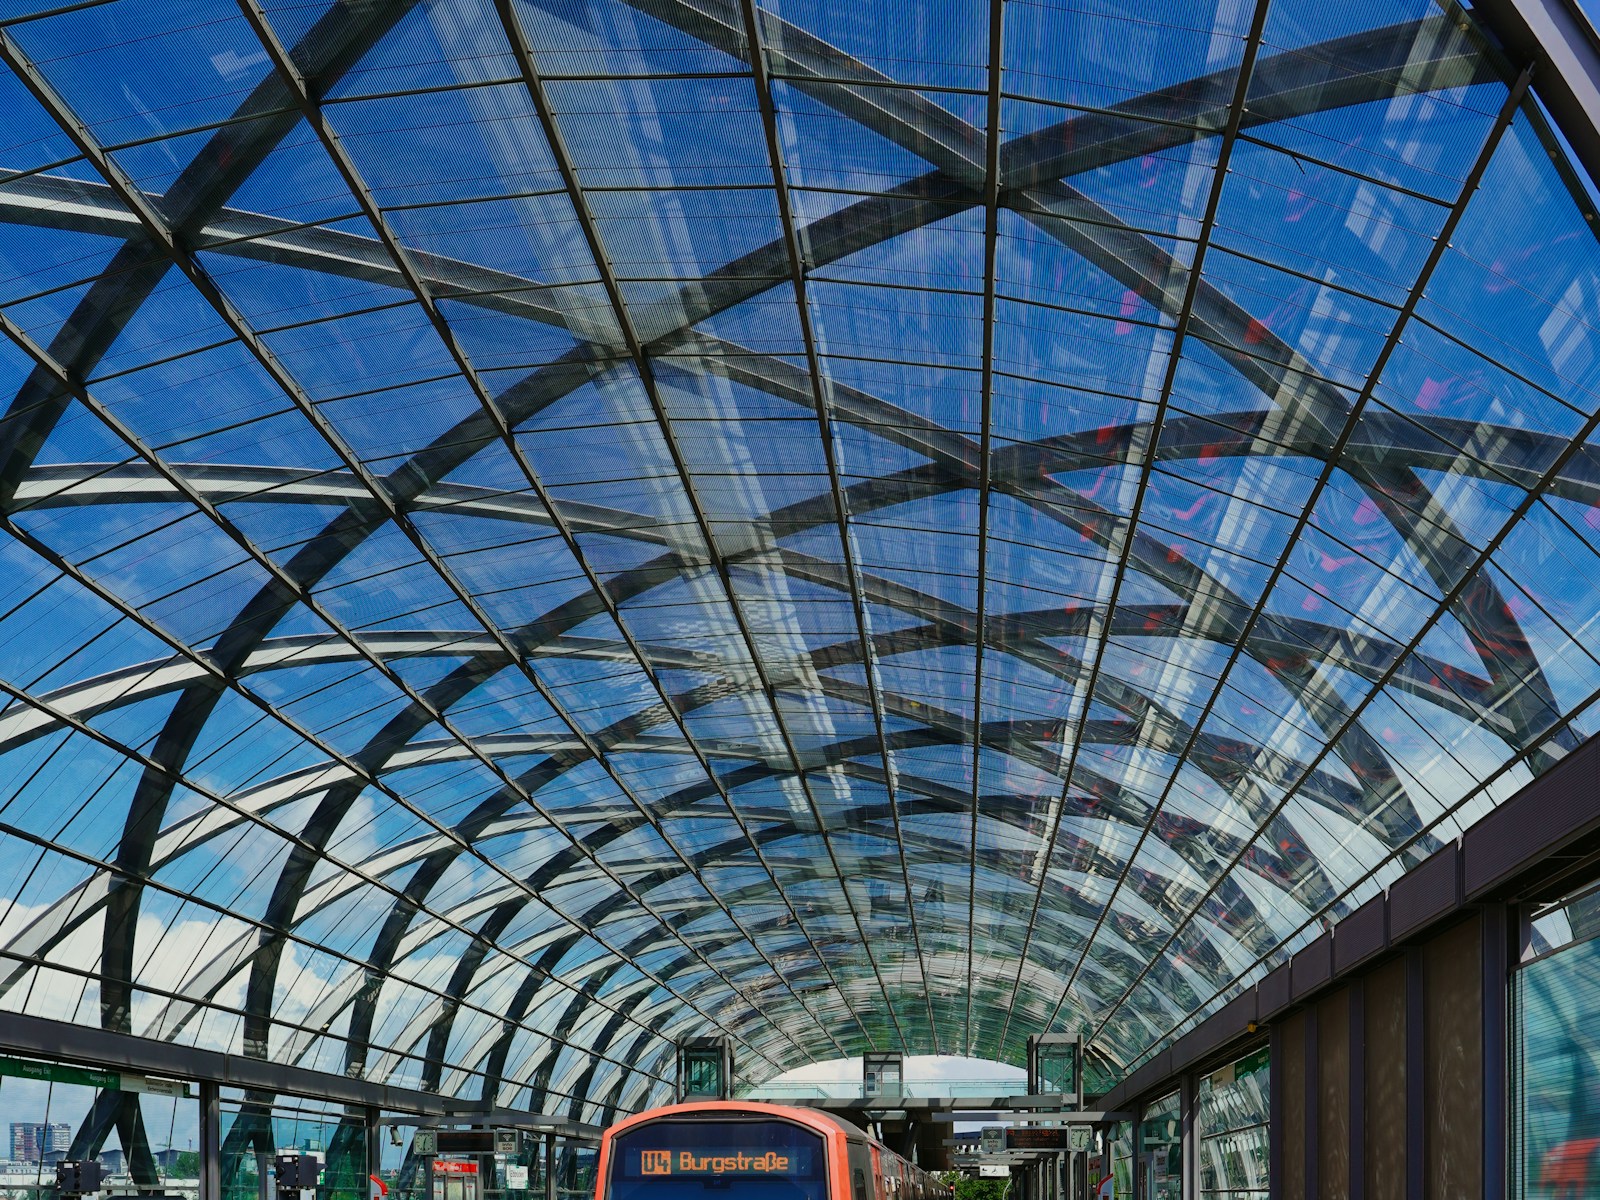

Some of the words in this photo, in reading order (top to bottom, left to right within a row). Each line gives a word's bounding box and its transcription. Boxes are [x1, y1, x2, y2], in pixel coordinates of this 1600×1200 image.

[22, 1064, 42, 1075] Ausgang
[89, 1073, 106, 1084] Ausgang
[643, 1152, 670, 1173] U4
[679, 1151, 789, 1173] Burgstraße
